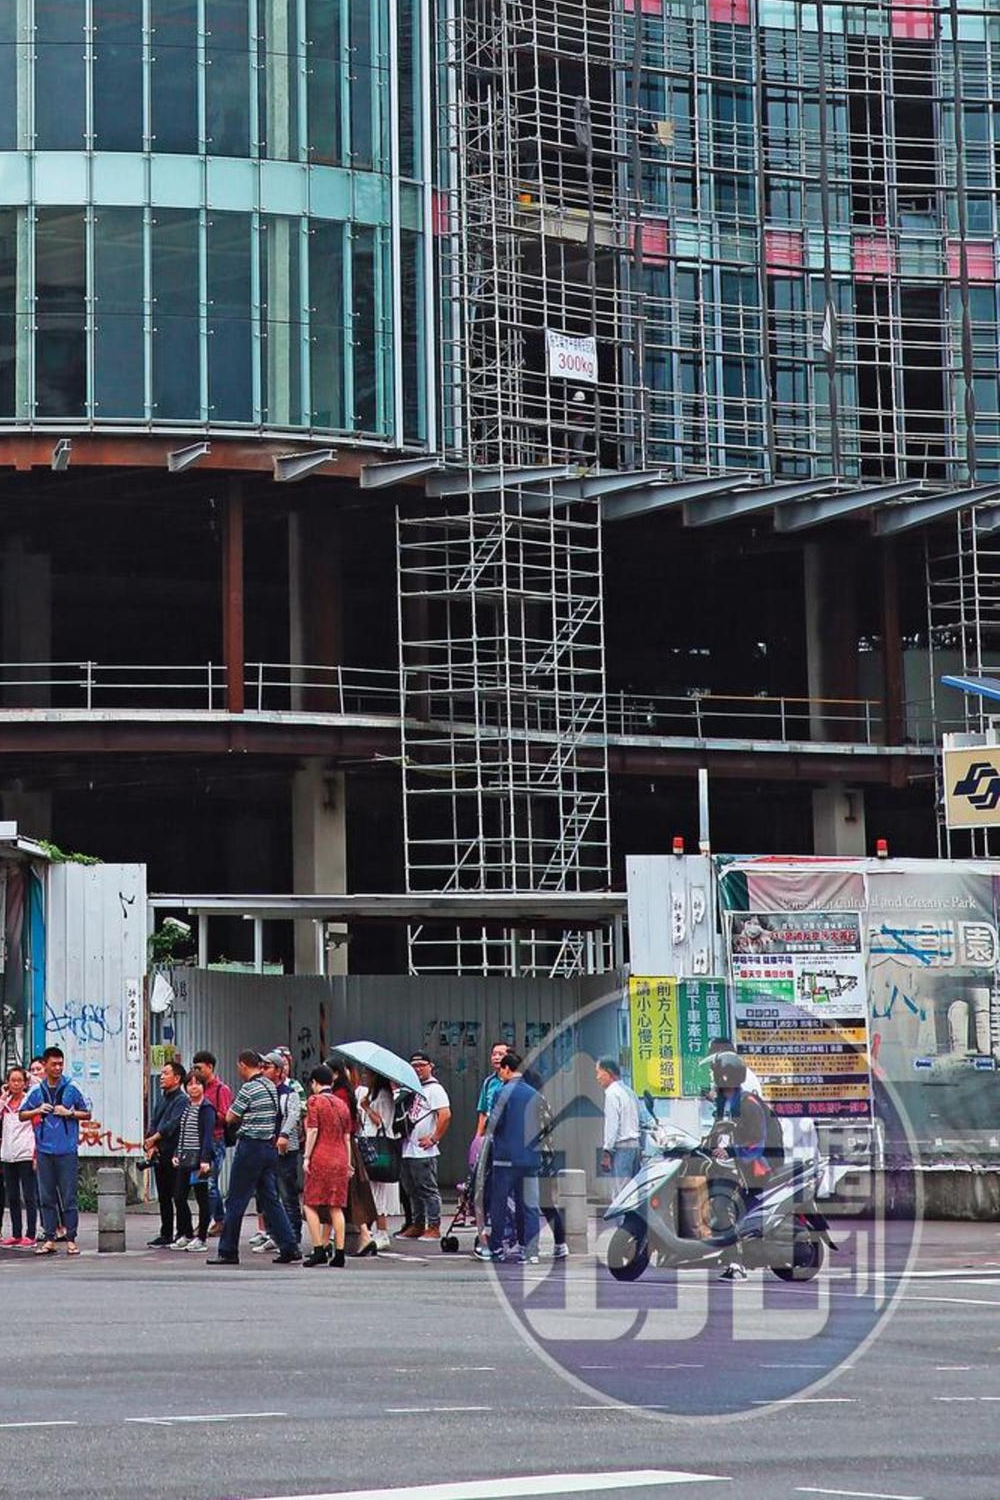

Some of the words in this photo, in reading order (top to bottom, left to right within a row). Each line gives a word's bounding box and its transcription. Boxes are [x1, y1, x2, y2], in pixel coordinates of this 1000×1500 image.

[559, 353, 593, 378] 300kg
[951, 896, 976, 909] Park
[636, 981, 652, 1060] 請小心慢行
[656, 982, 675, 1092] 前方人行道縮減
[686, 980, 701, 1052] 請下車牽行
